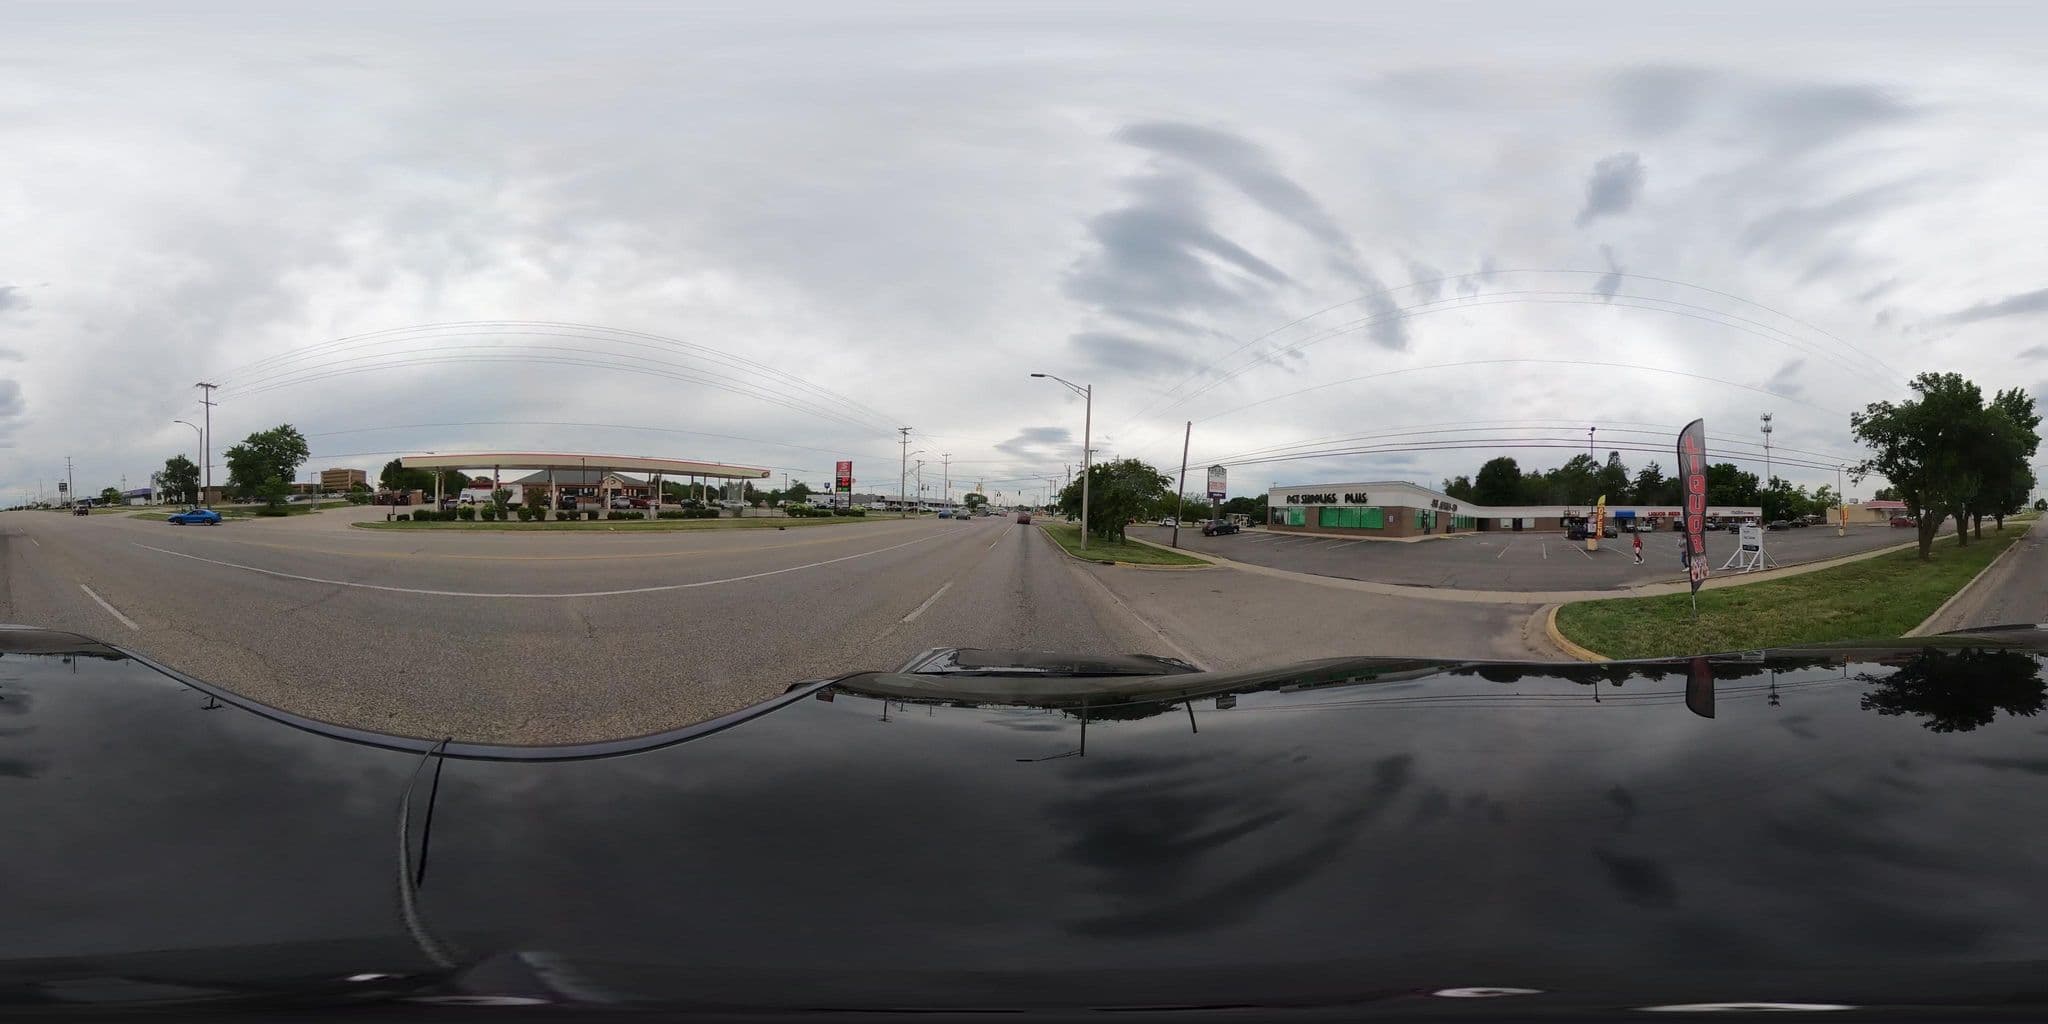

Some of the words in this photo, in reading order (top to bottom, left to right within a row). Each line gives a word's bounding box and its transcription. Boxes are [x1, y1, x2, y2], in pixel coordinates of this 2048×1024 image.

[1286, 494, 1300, 504] PET
[1301, 493, 1338, 504] SUPPLIES
[1344, 492, 1368, 504] PLUS
[1685, 435, 1706, 553] LIQUOR
[1596, 507, 1604, 537] OPEN
